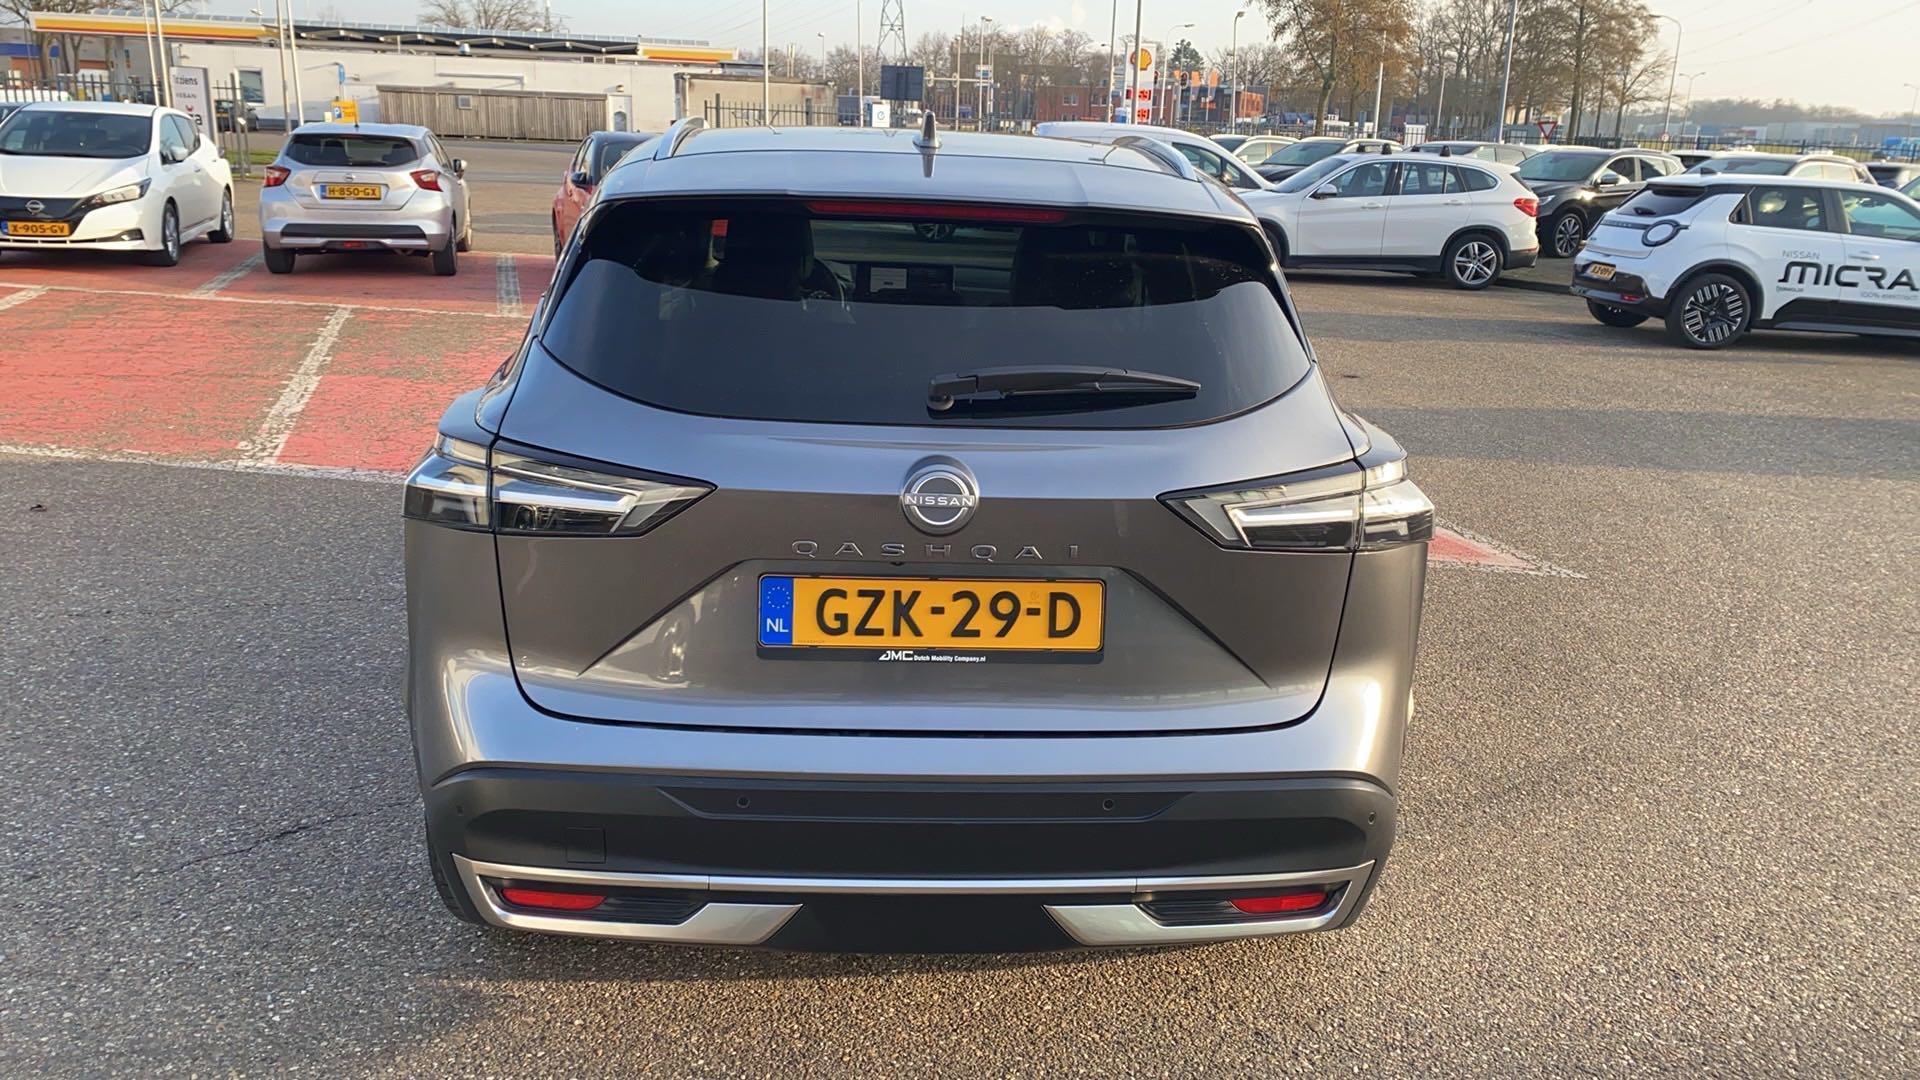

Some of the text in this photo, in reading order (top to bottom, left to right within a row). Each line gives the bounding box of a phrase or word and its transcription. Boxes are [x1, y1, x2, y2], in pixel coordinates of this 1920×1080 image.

[328, 187, 377, 196] H-850-GX
[11, 224, 65, 233] X-905-GV
[1782, 250, 1820, 260] NISSAN
[1777, 261, 1919, 291] MICRA
[905, 495, 974, 506] NISSAN
[792, 540, 1078, 562] QASHQAI
[816, 588, 1081, 638] GZK-29-D
[766, 618, 789, 632] NL
[931, 655, 953, 663] Mobility
[954, 655, 986, 663] Company.nl
